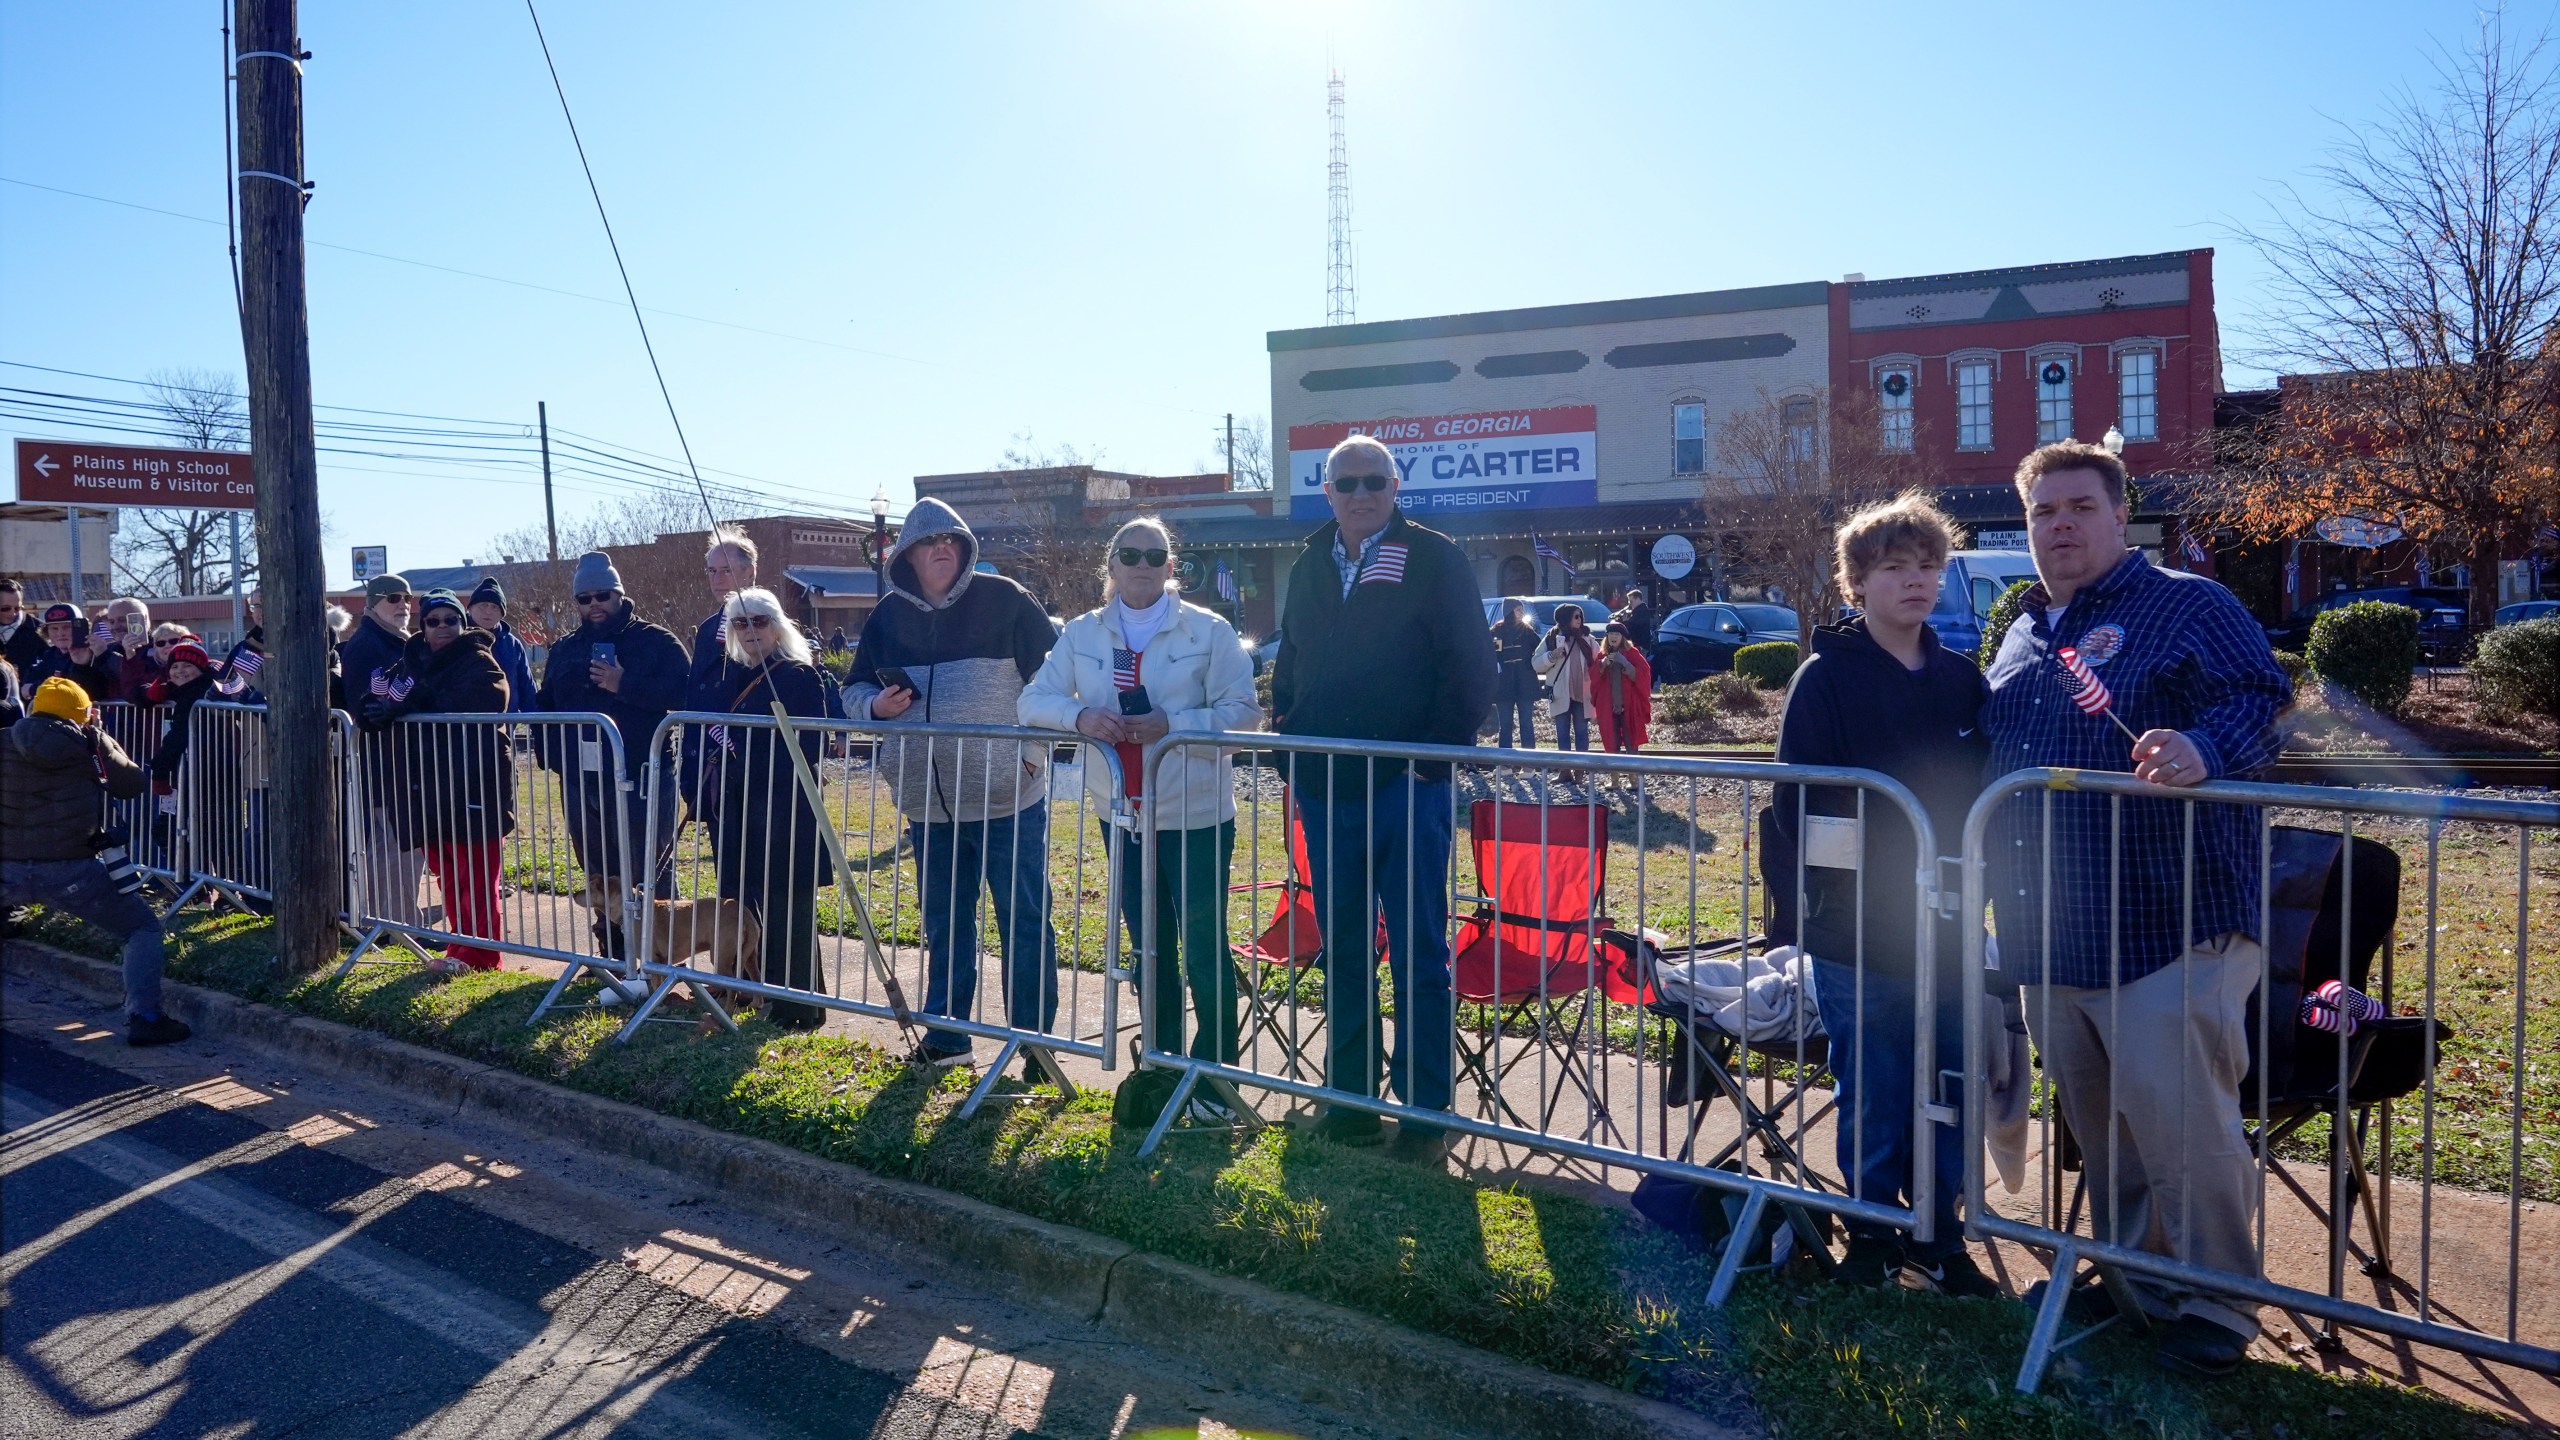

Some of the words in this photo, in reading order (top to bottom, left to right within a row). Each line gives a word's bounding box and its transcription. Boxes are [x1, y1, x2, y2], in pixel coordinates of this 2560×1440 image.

[1434, 415, 1532, 436] GEORGIA
[1394, 444, 1446, 455] HOME
[1457, 442, 1480, 451] OF
[73, 455, 125, 470] Plains
[133, 458, 170, 475] High
[177, 460, 230, 476] School
[1432, 446, 1580, 480] CARTER
[74, 474, 142, 490] Museum
[150, 478, 160, 490] &
[168, 478, 219, 493] Visitor
[1432, 490, 1531, 507] PRESIDENT
[1980, 539, 2009, 547] TRADING
[1990, 532, 2017, 540] PLAINS
[1651, 551, 1696, 560] SOUTHWEST
